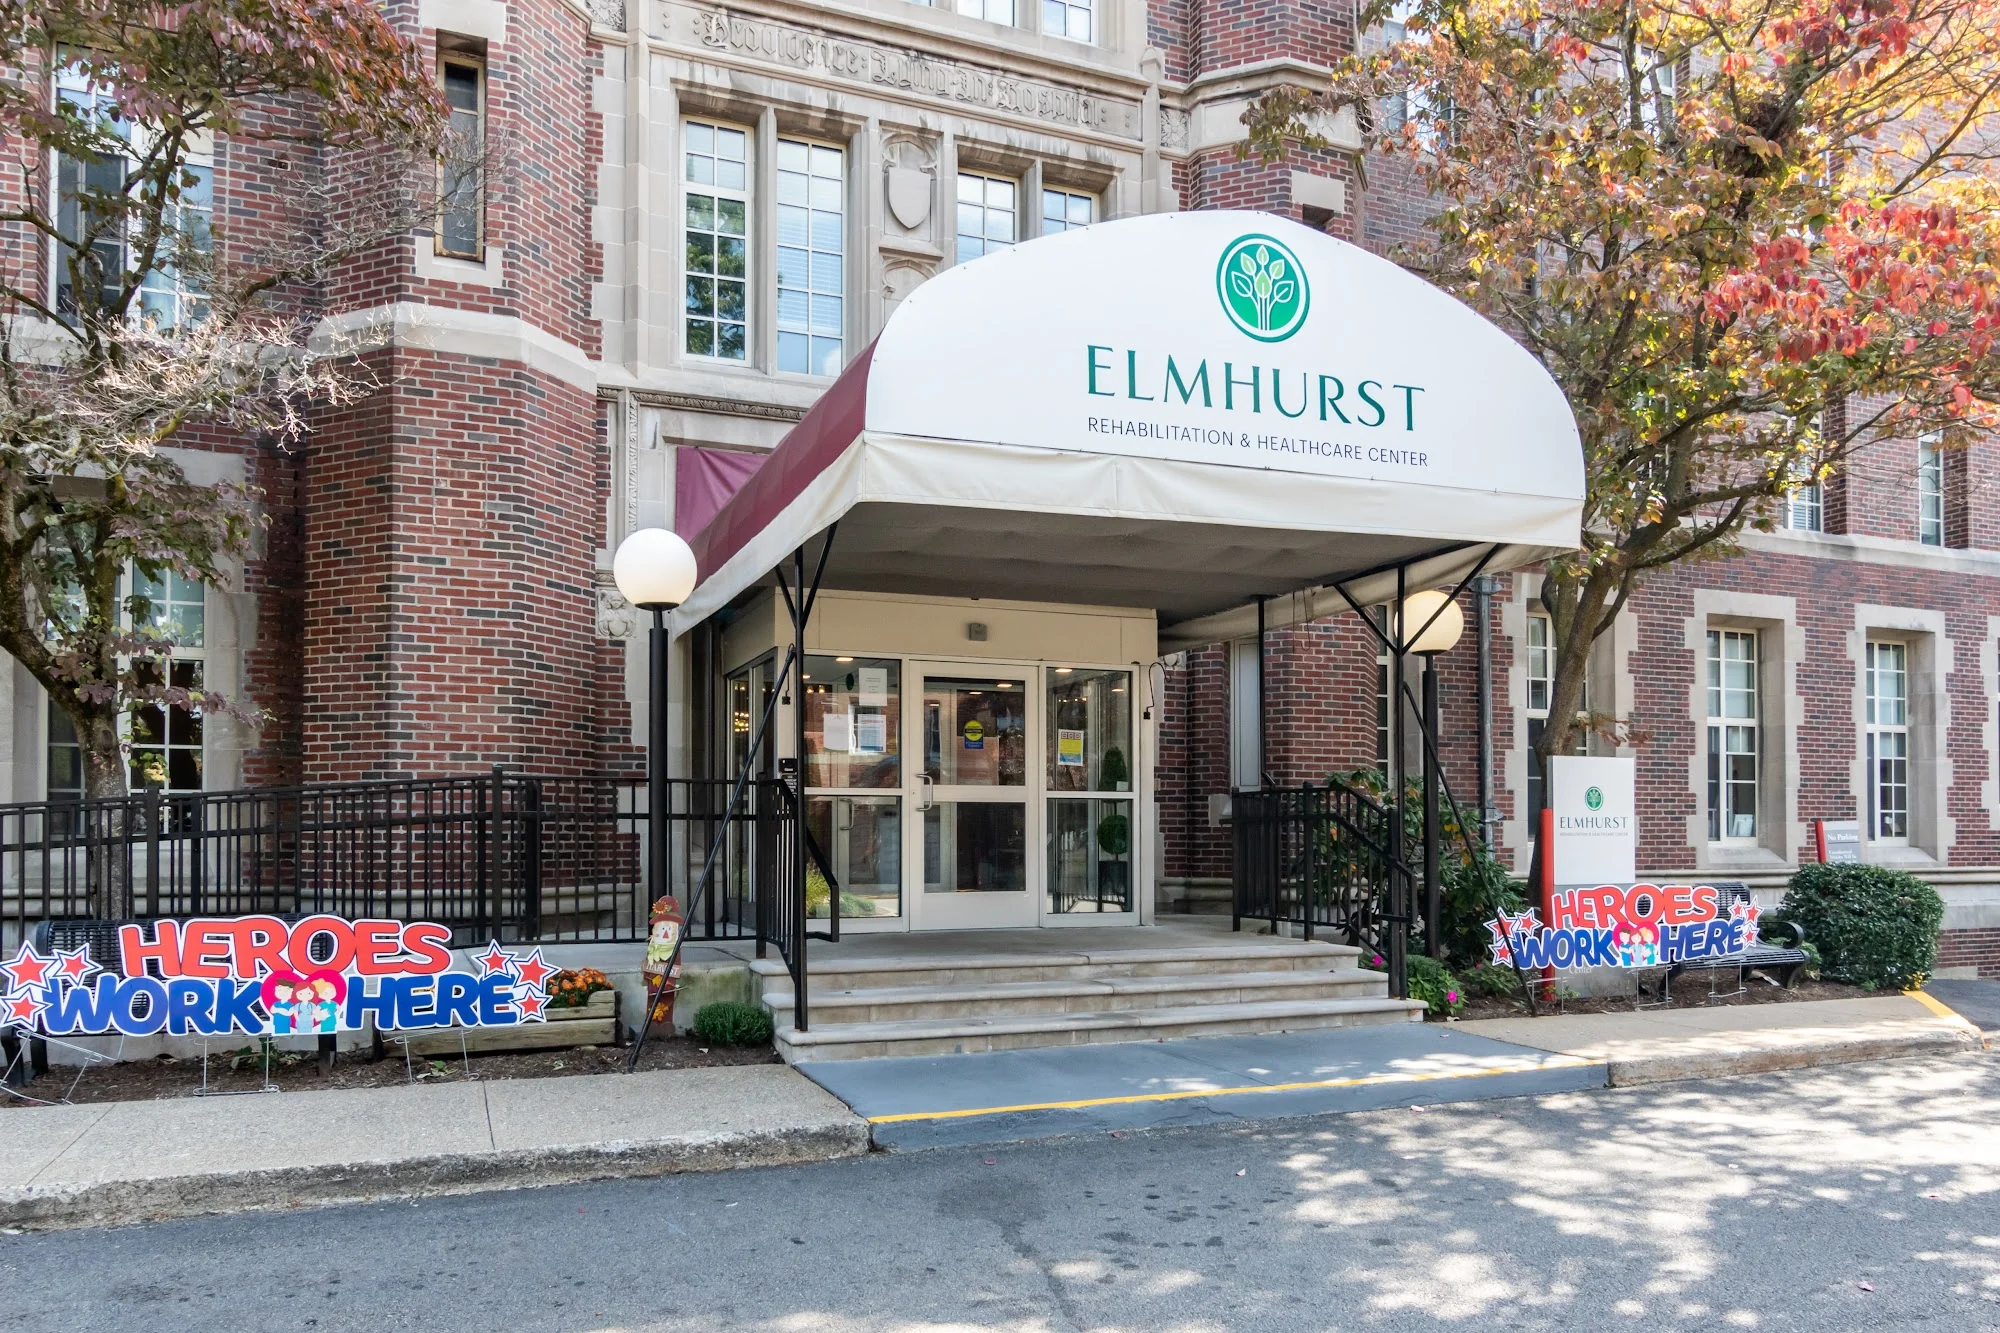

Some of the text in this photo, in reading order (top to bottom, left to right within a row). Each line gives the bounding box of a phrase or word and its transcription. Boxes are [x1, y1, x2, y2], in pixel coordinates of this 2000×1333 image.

[1086, 344, 1425, 432] ELMHURST
[1088, 417, 1428, 467] REHABILITATION & HEALTHCARE CENTER
[1559, 816, 1629, 829] ELMHURST
[1837, 833, 1859, 841] Parking
[1551, 885, 1719, 930] HEROES
[120, 917, 452, 979] HEROES
[1514, 918, 1747, 969] WORK HERE
[47, 973, 519, 1036] WORK HERE
